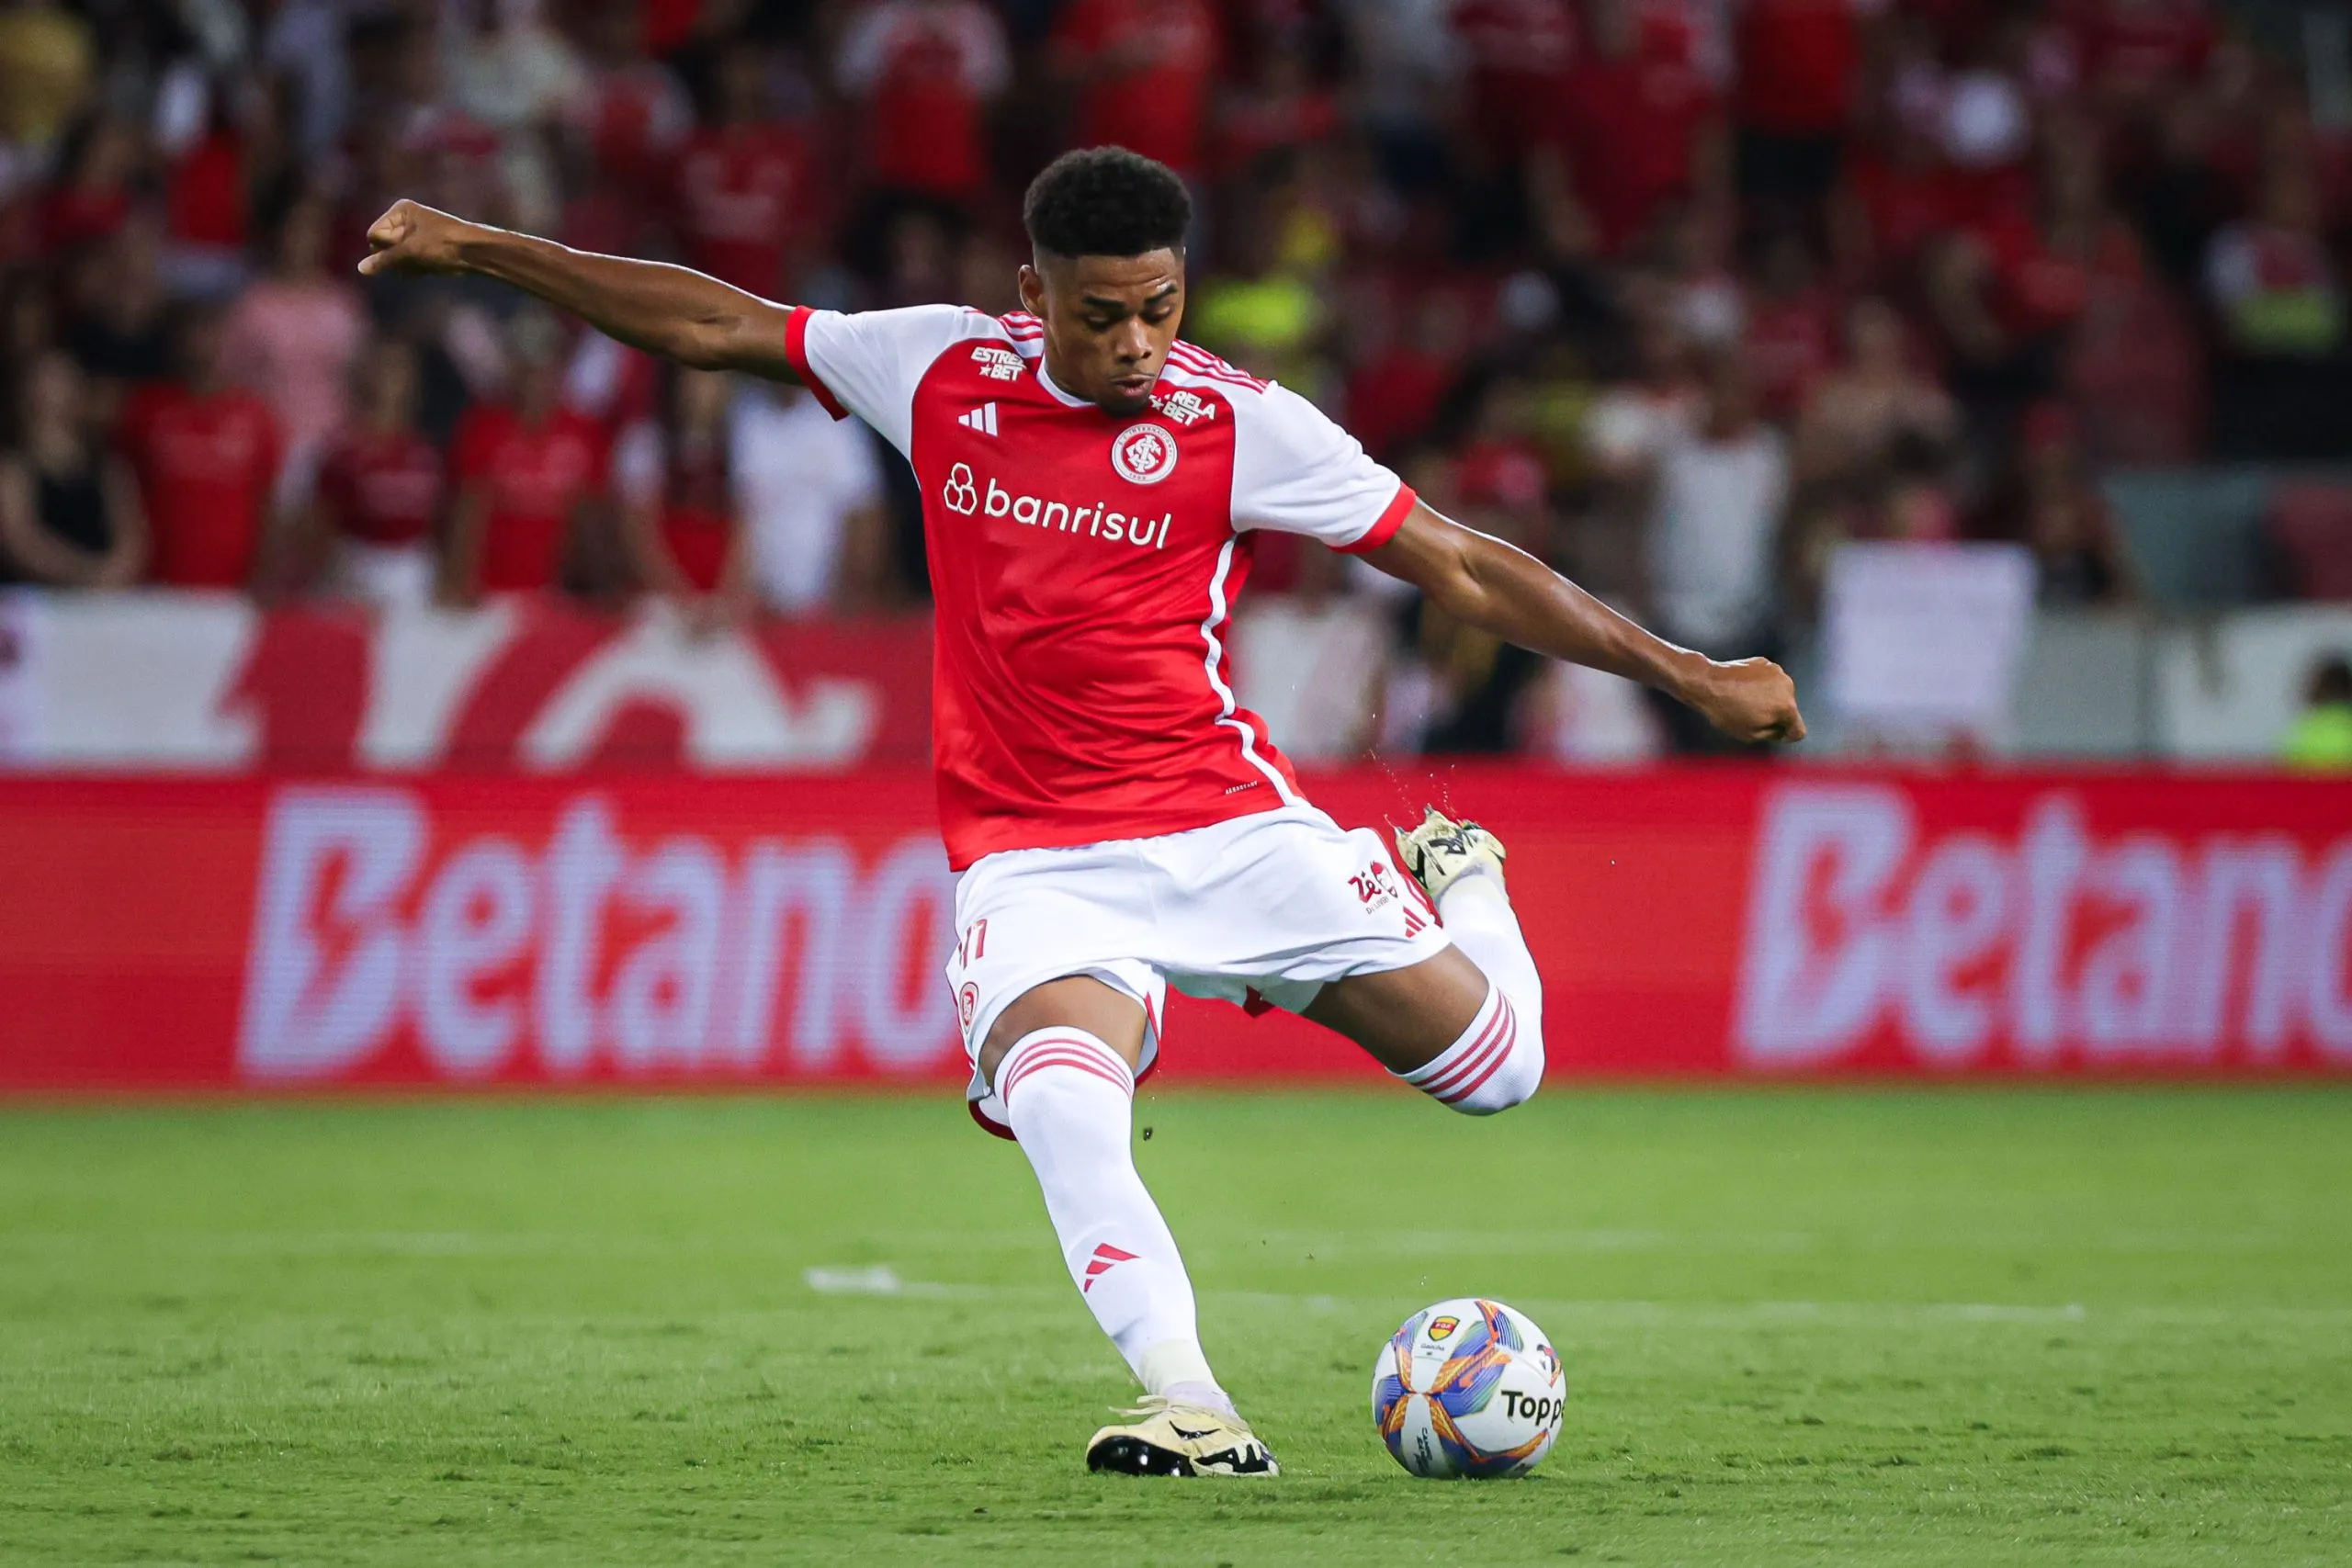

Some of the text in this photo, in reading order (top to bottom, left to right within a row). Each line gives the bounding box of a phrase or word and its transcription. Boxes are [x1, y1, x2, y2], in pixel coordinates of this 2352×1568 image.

[970, 346, 1027, 369] ESTRE
[990, 364, 1023, 381] BET
[1162, 401, 1200, 426] BET
[1164, 390, 1216, 421] RELA
[984, 478, 1172, 549] banrisul
[243, 790, 958, 1075] Betano
[1500, 1389, 1565, 1428] Topp
